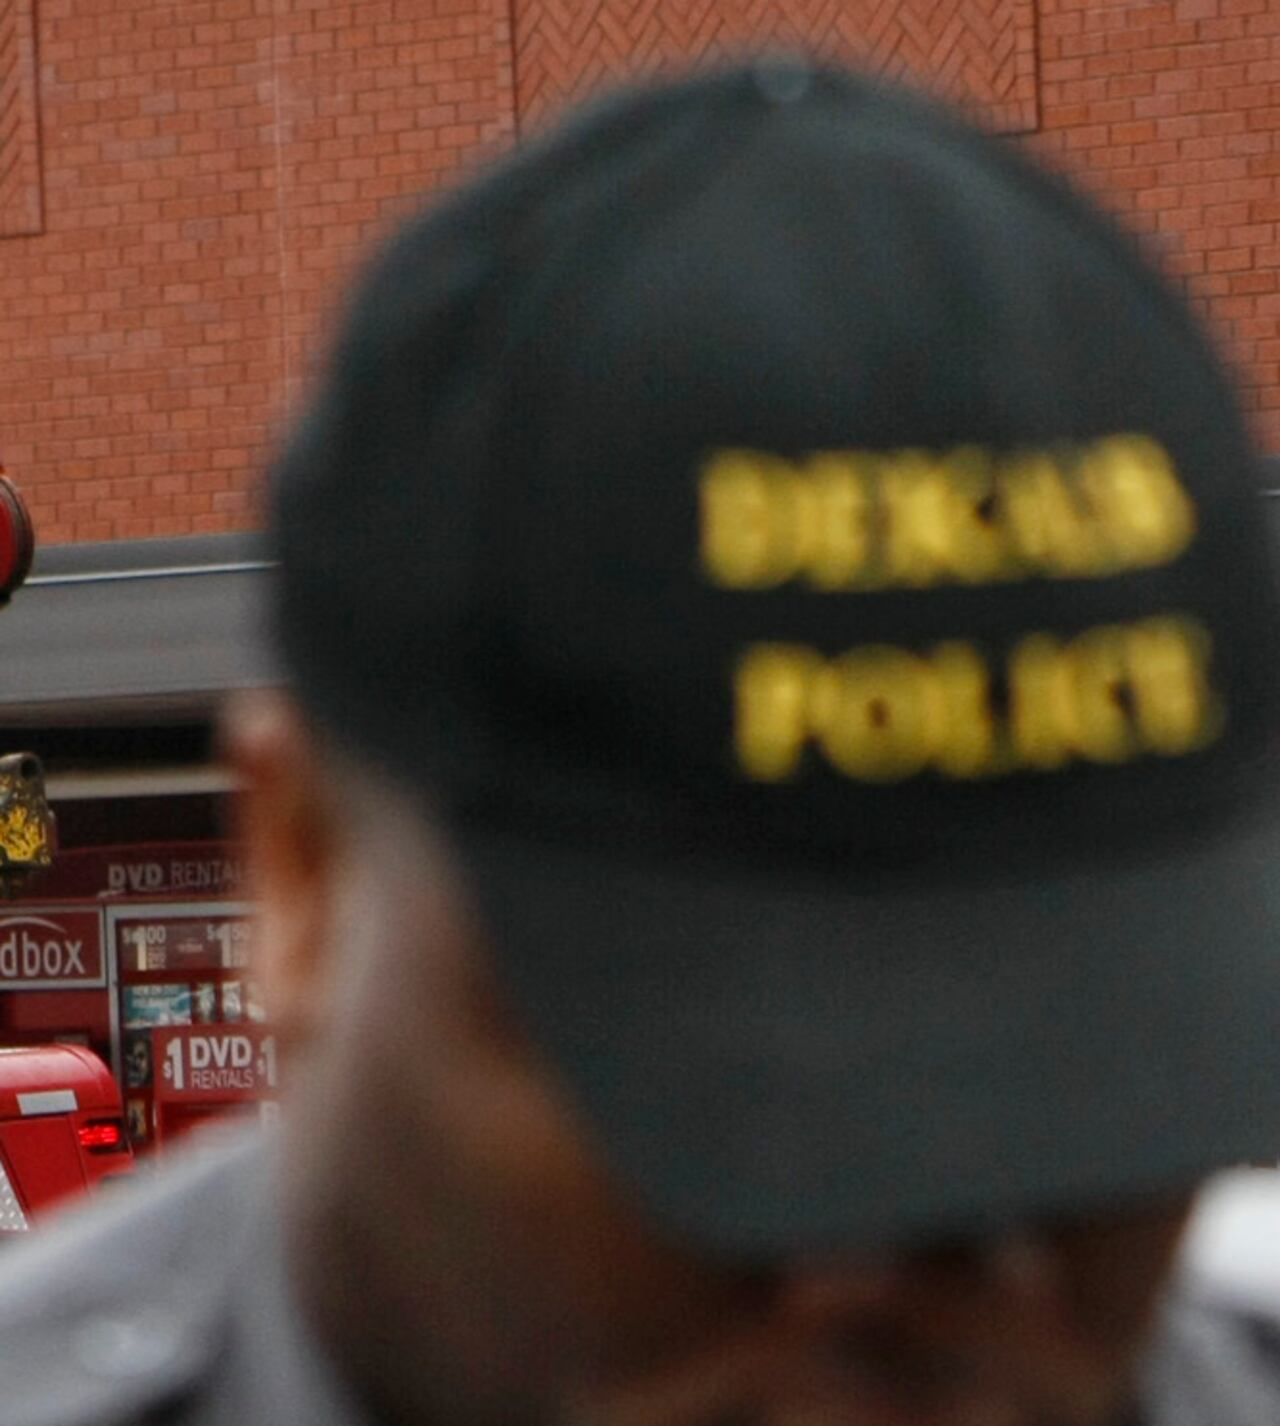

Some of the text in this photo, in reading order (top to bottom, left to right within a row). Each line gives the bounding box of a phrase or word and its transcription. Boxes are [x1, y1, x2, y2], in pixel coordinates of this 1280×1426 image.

[108, 860, 250, 891] DVD RENTAL
[163, 1037, 184, 1090] $1
[190, 1036, 253, 1068] DVD
[190, 1068, 253, 1089] RENTALS
